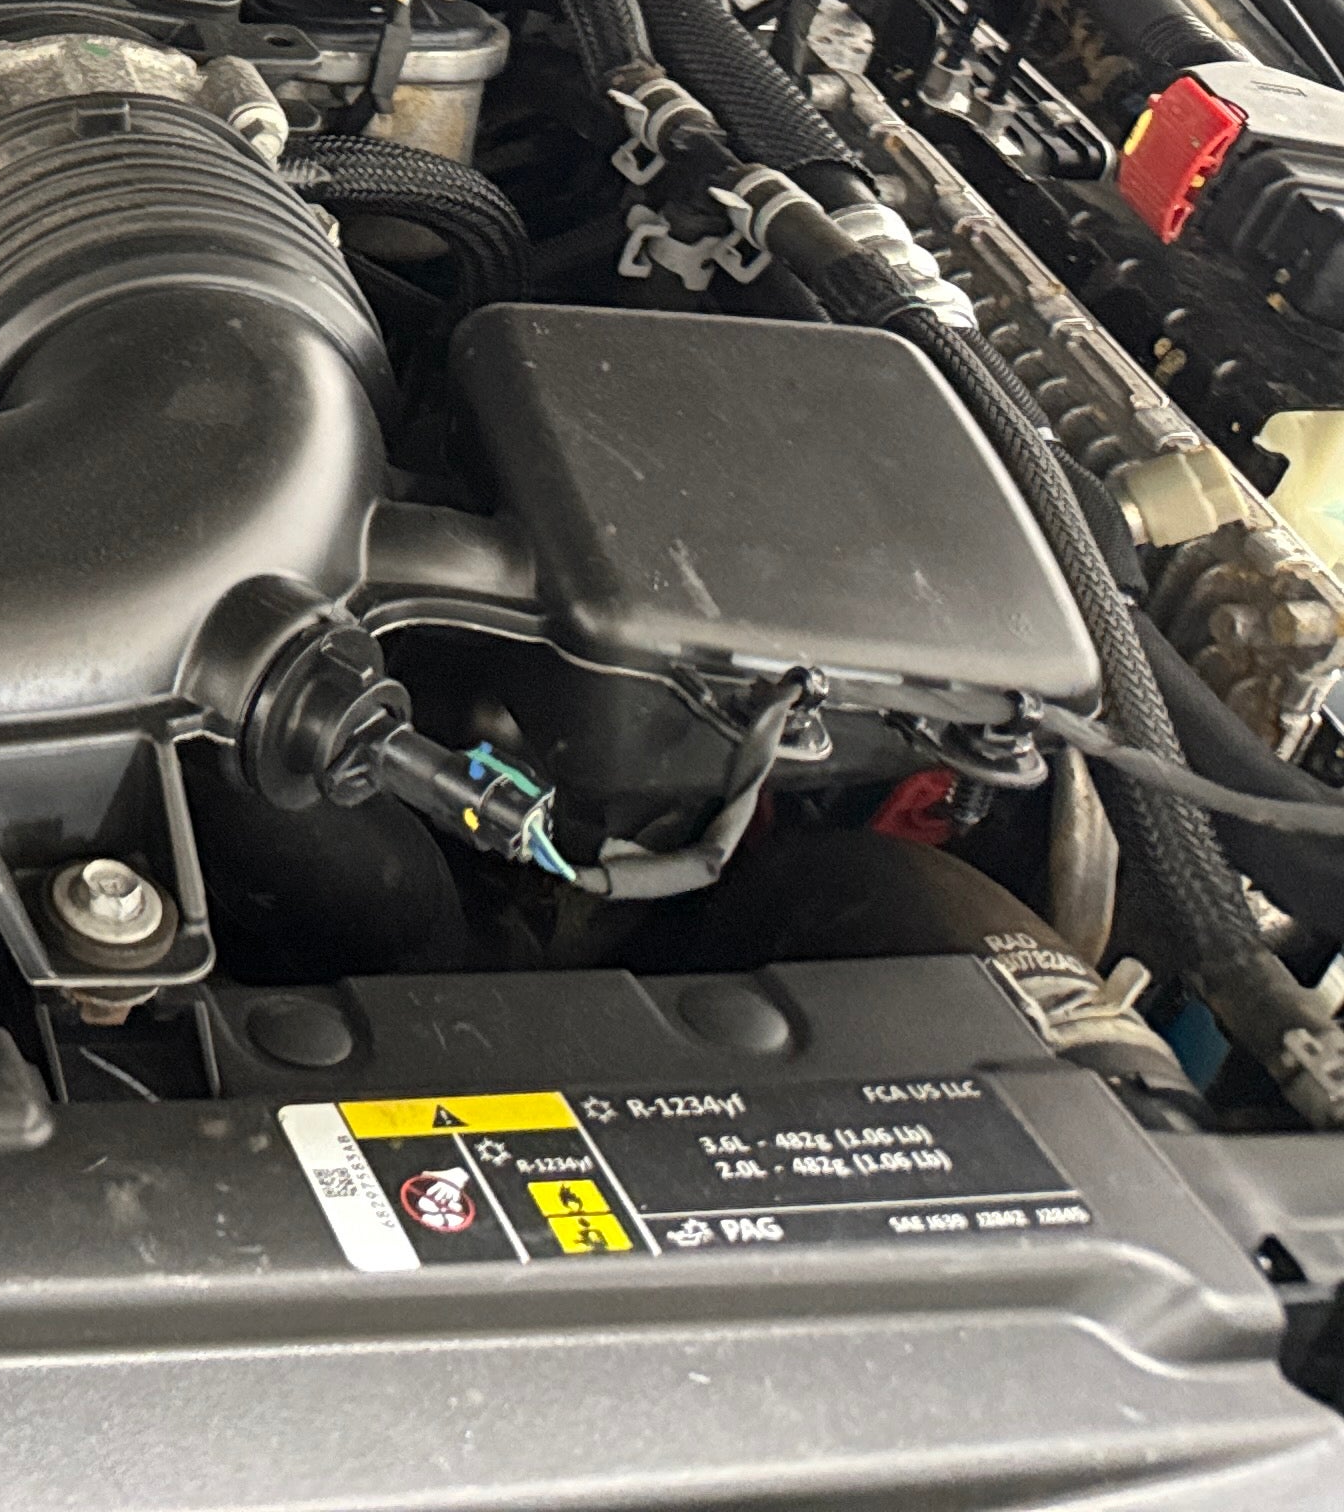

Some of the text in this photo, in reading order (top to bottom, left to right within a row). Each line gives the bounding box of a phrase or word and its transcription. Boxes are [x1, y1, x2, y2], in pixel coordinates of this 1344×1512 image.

[983, 932, 1039, 953] RAD
[862, 1079, 982, 1103] FCA US LLC
[625, 1091, 748, 1120] R-1234yf
[699, 1135, 752, 1156] 3.6L
[775, 1130, 834, 1153] 482g
[834, 1127, 896, 1150] (1.06
[892, 1124, 934, 1147] Lb)
[515, 1155, 594, 1174] R-1234yf
[714, 1159, 770, 1180] 2.0L
[792, 1155, 855, 1178] 482g
[852, 1152, 914, 1176] (1.06
[910, 1148, 954, 1173] Lb)
[719, 1215, 786, 1243] PAG
